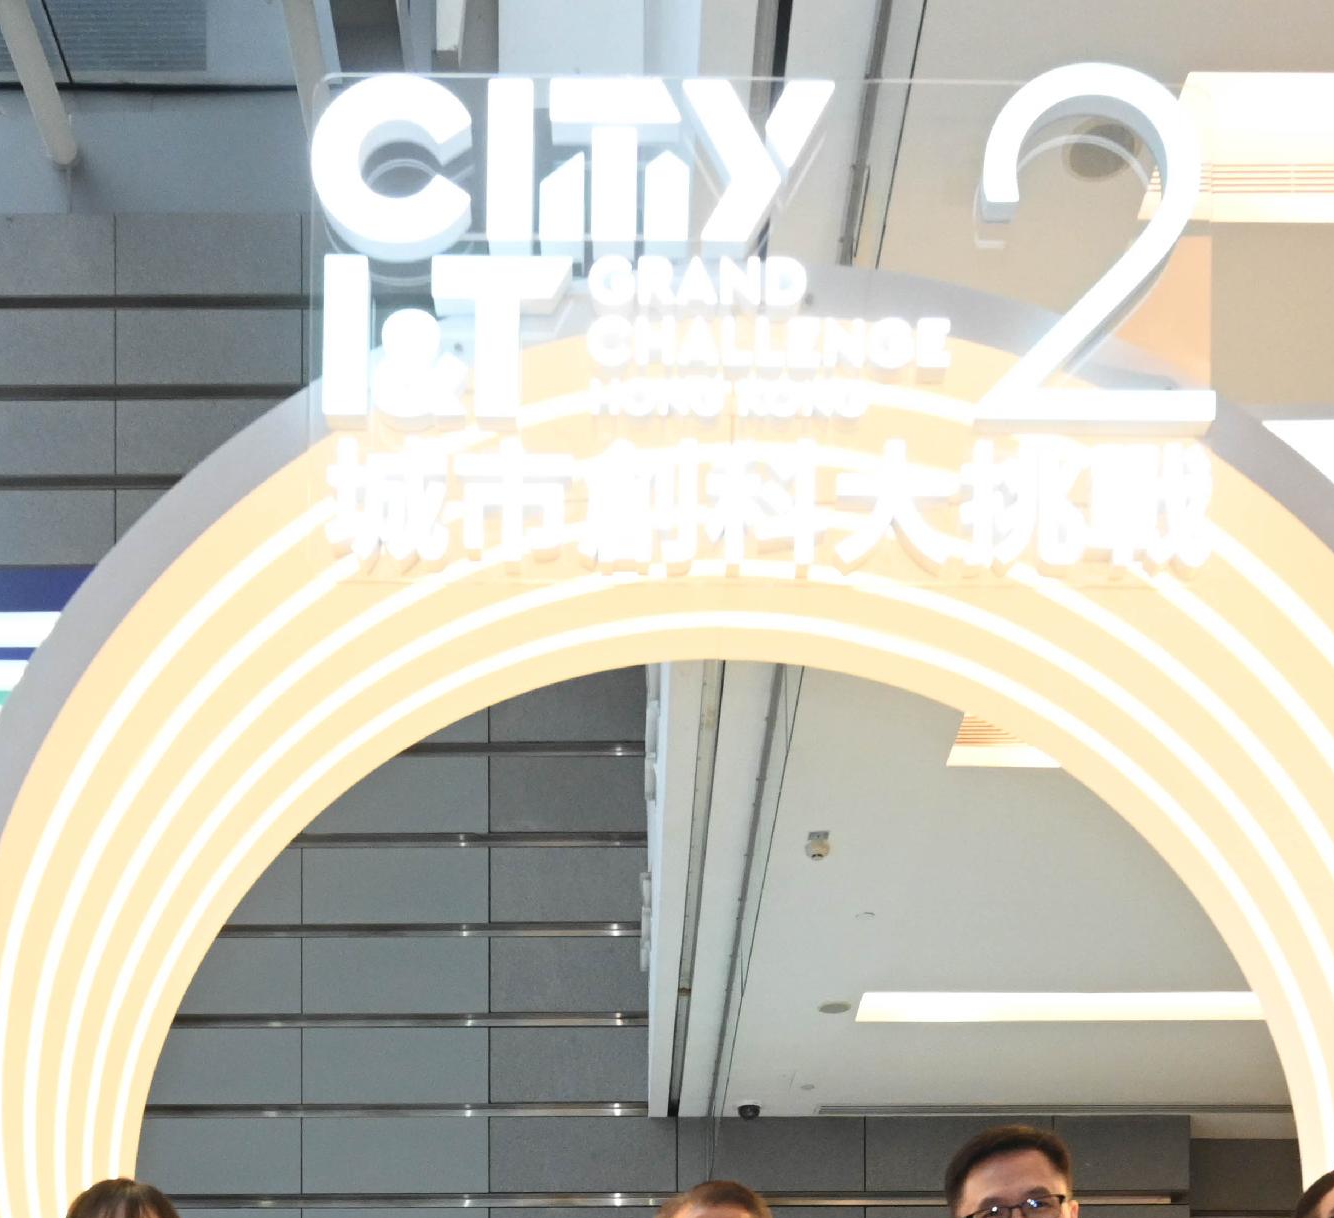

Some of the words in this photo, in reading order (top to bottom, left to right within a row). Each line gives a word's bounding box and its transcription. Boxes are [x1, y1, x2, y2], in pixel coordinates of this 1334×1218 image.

[312, 74, 835, 256] CITY
[587, 255, 808, 308] GRAND
[975, 62, 1216, 430] 2
[322, 254, 572, 428] I&T
[587, 316, 951, 370] CHALLENGE
[590, 378, 726, 419] HONG
[736, 378, 867, 419] KONG
[326, 438, 1214, 573] 城市創科大挑戰
